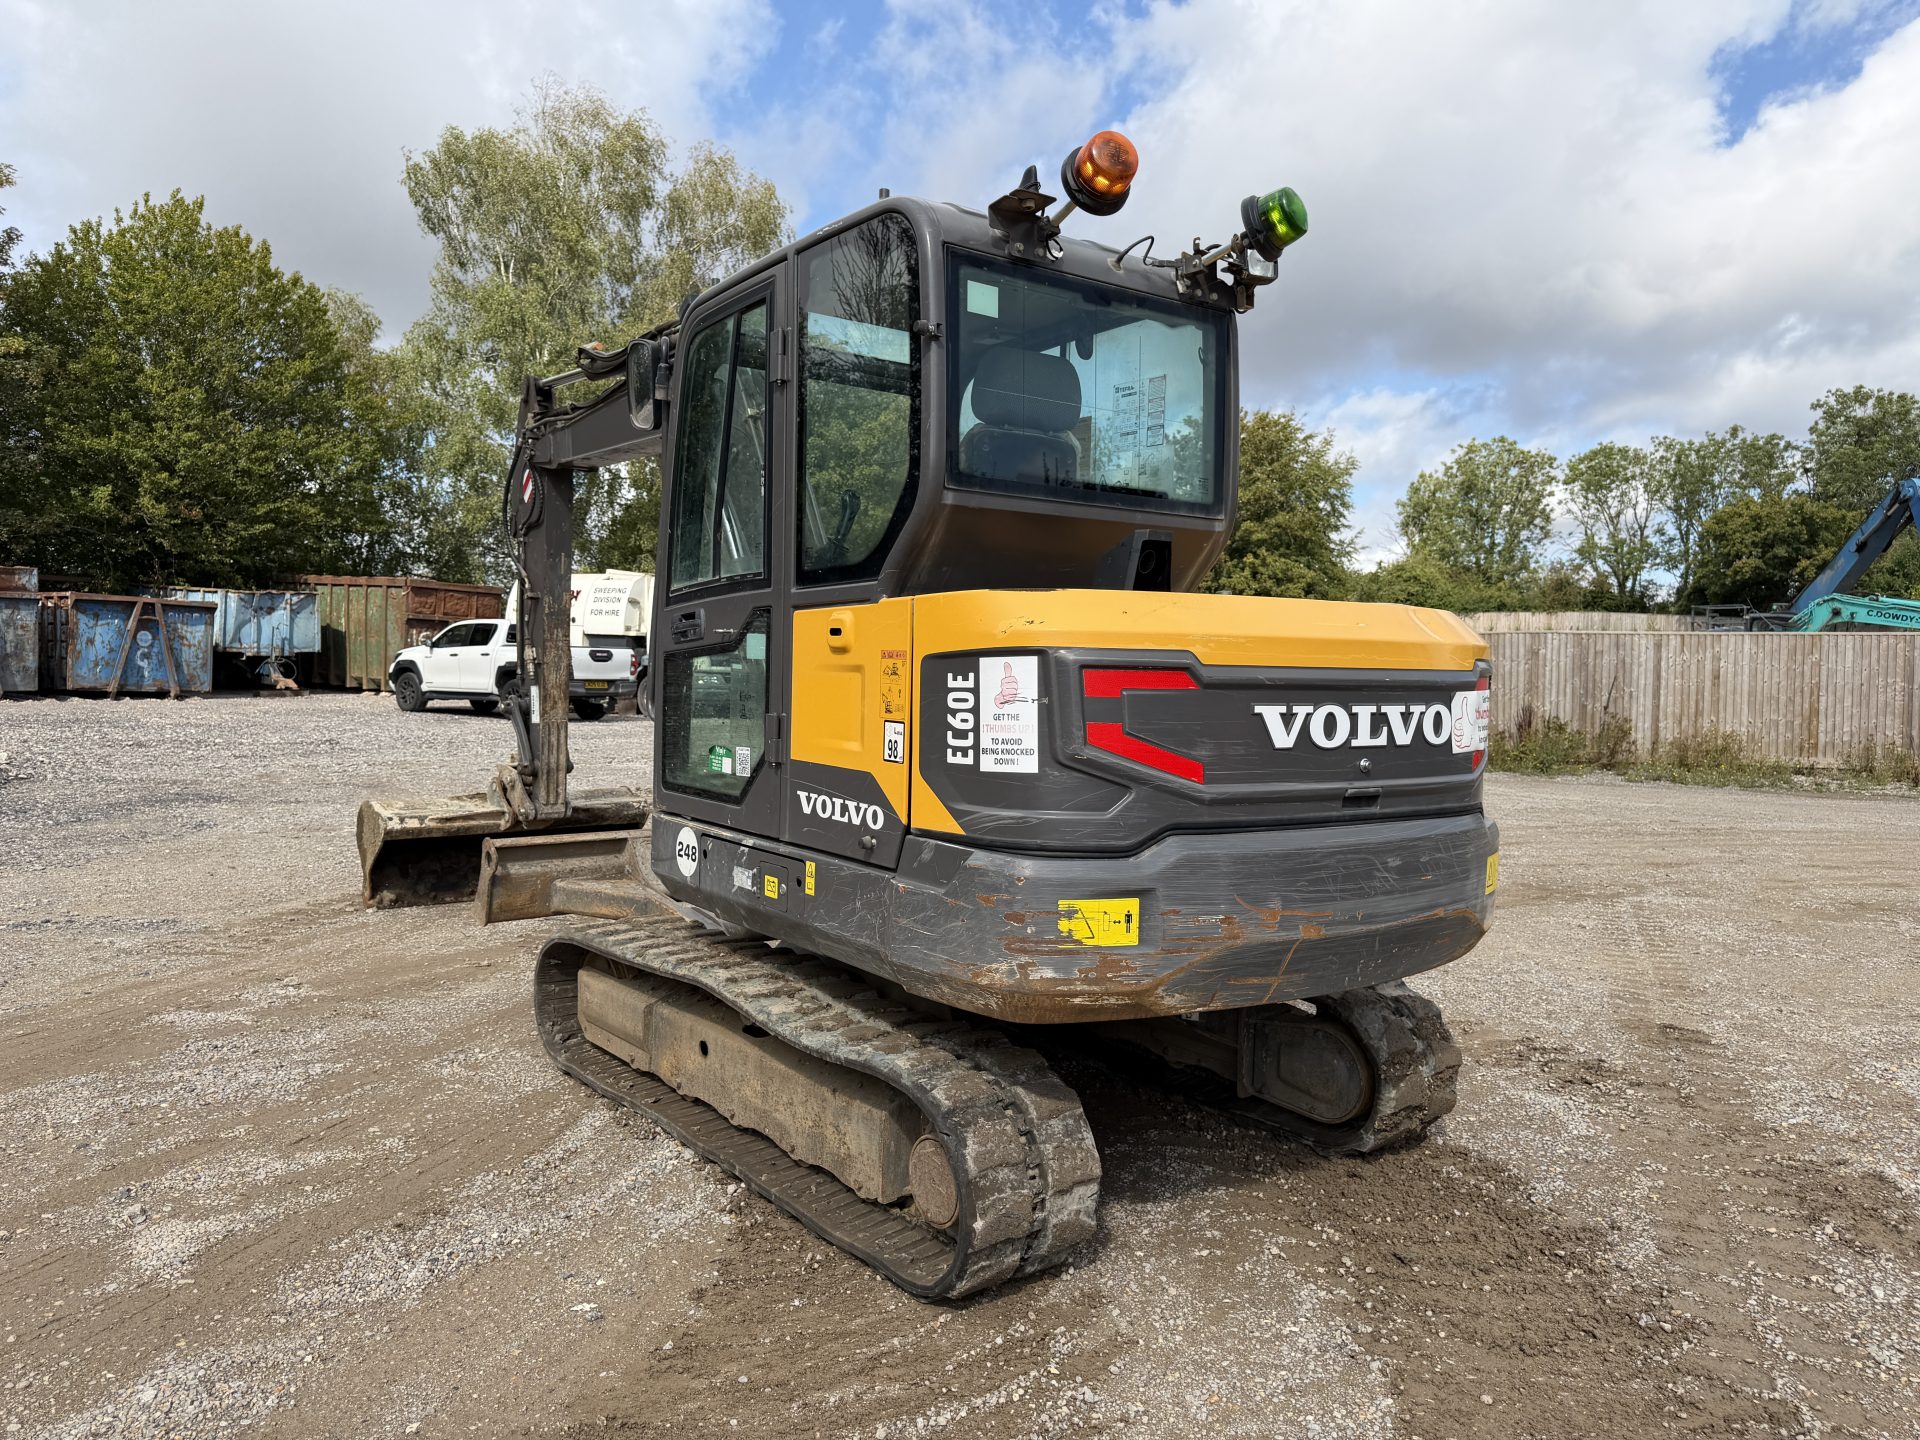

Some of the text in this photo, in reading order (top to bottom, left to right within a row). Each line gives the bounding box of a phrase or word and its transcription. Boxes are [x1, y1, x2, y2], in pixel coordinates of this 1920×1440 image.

[590, 608, 603, 616] FOR
[947, 672, 975, 765] EC60E
[992, 713, 1020, 721] GET THE
[1253, 703, 1452, 749] VOLVO
[887, 738, 899, 760] 98
[990, 737, 1023, 746] TO AVOID
[981, 747, 1035, 756] BEING KNOCKED
[994, 757, 1016, 766] DOWN
[796, 790, 885, 830] VOLVO
[677, 840, 697, 863] 248
